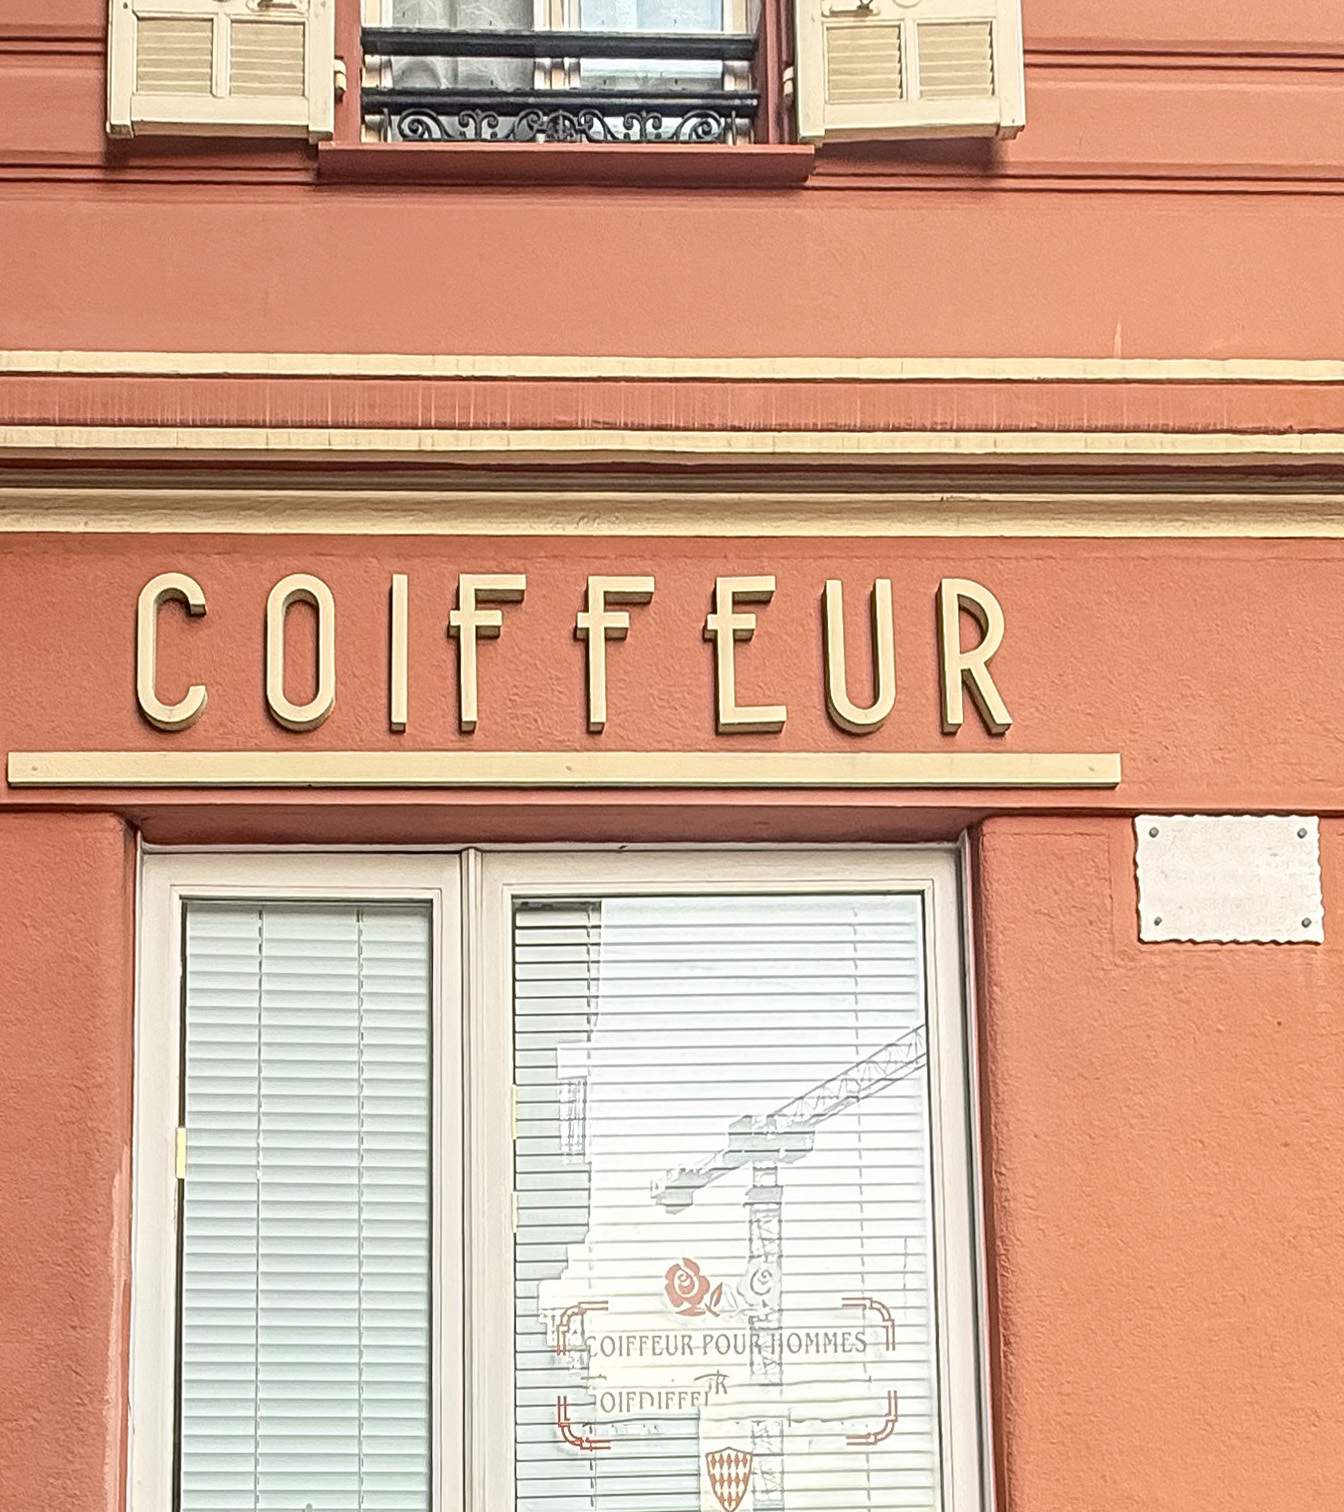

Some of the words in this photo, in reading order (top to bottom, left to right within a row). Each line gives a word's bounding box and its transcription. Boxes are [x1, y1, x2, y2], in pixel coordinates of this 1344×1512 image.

[134, 571, 1014, 736] COIFFEUR
[585, 1334, 695, 1358] COIFFEUR
[701, 1333, 763, 1356] POUR
[770, 1331, 869, 1355] HOMMES
